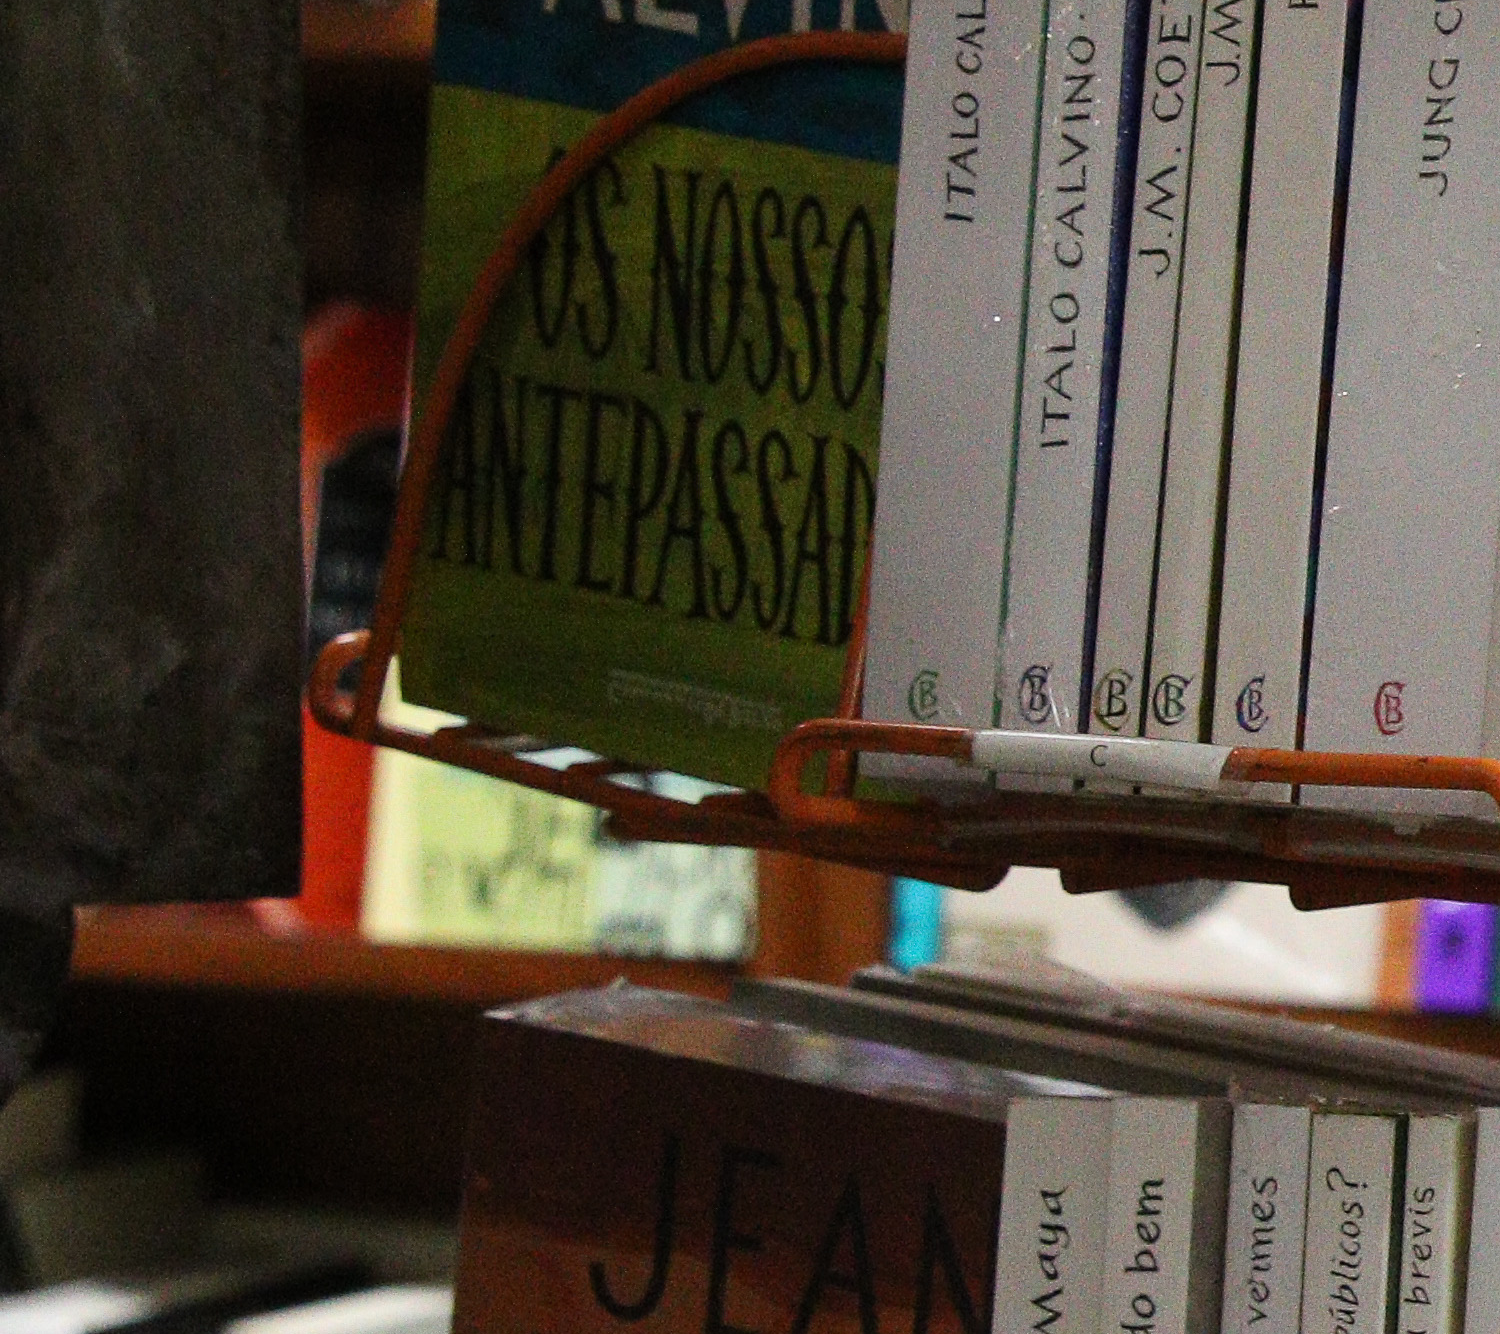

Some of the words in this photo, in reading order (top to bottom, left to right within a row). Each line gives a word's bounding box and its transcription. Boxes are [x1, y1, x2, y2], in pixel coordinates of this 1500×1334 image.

[944, 93, 981, 223] ITALO
[1055, 35, 1097, 269] CALVINO
[1418, 57, 1459, 196] JUNG
[644, 163, 894, 412] NOSSO
[1041, 292, 1081, 449] ITALO
[1125, 1175, 1165, 1273] bem
[1246, 1175, 1281, 1325] vermes
[1404, 1184, 1437, 1308] brevis
